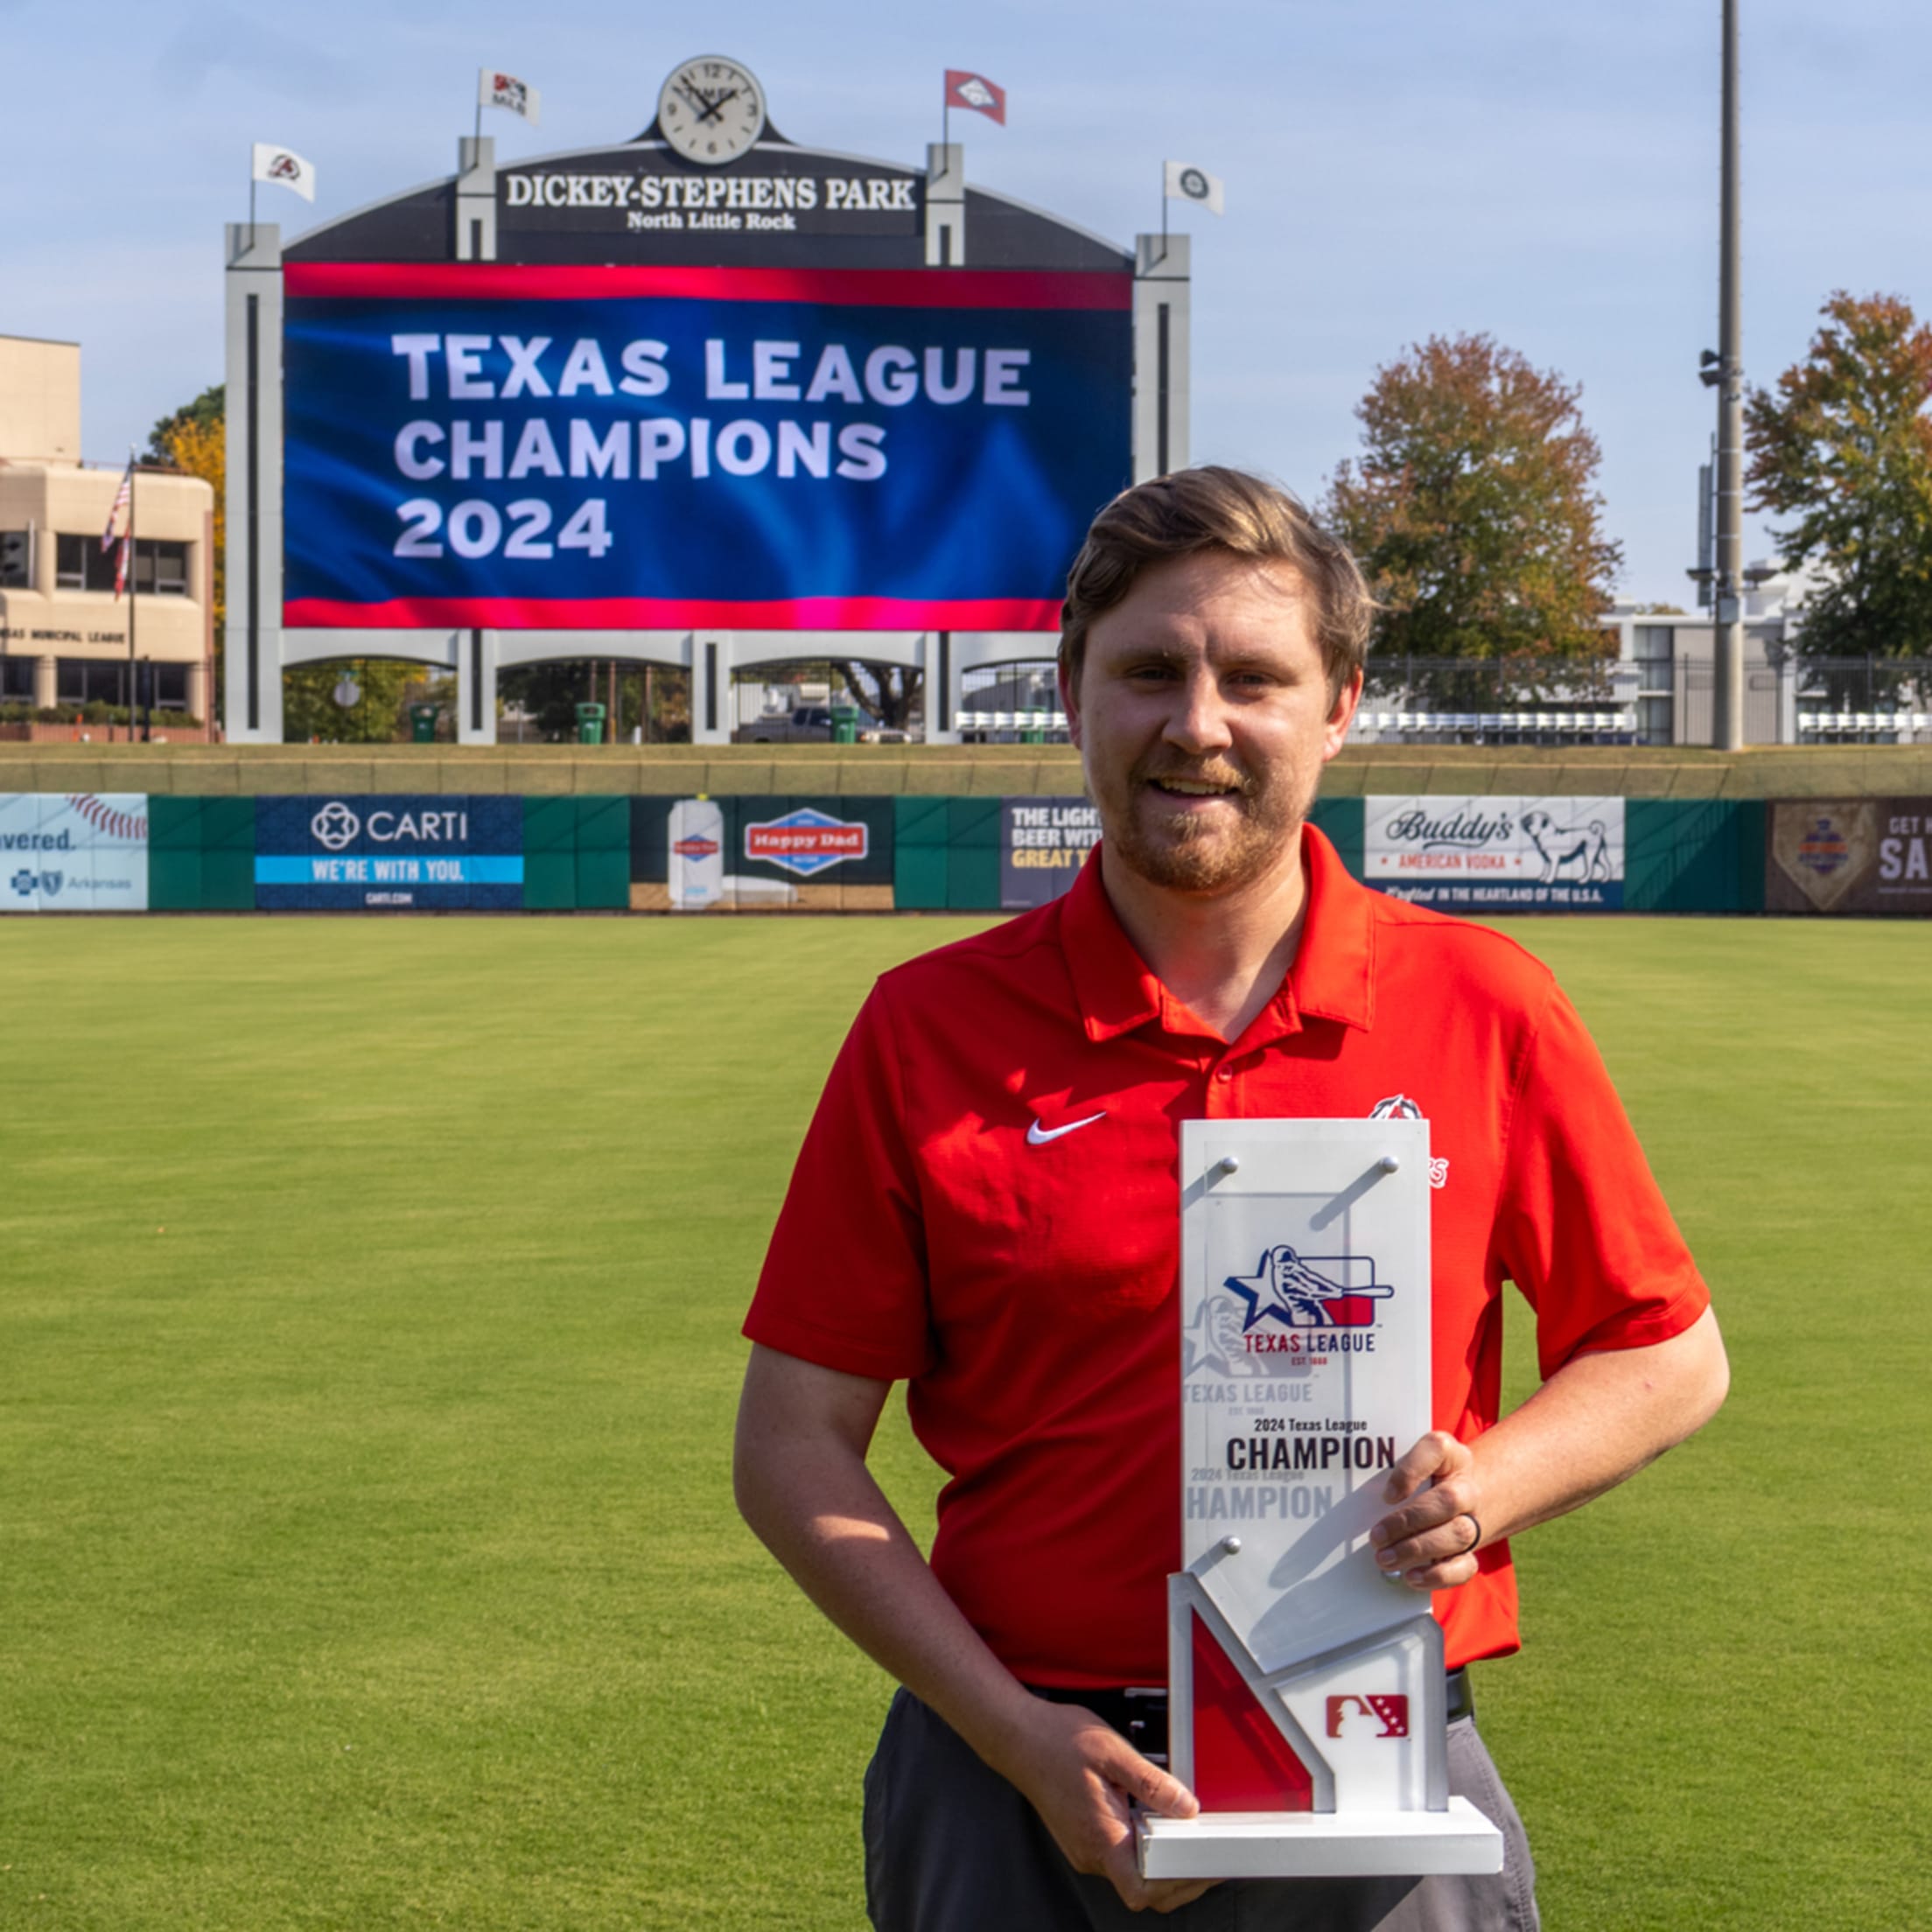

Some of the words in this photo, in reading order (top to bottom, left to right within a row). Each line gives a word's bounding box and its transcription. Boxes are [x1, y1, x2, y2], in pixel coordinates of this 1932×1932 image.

[506, 175, 818, 210] DICKEY-STEPHENS
[824, 178, 917, 210] PARK
[626, 212, 683, 229] North
[688, 212, 742, 230] Little
[746, 213, 796, 231] Rock
[391, 332, 670, 400] TEXAS
[704, 339, 1031, 406] LEAGUE
[394, 417, 887, 480] CHAMPIONS
[394, 498, 613, 558] 2024
[88, 632, 124, 644] LEAGUE
[367, 810, 467, 841] CARTI
[1012, 807, 1049, 827] THE
[1890, 816, 1920, 835] GET
[0, 828, 77, 851] vered.
[1012, 828, 1060, 847] BEER
[1386, 810, 1514, 850] Buddy's
[753, 834, 816, 850] Happy
[820, 833, 858, 847] Dad
[1012, 849, 1073, 868] GREAT
[1398, 854, 1461, 869] AMERICAN
[1466, 855, 1506, 869] VODKA
[312, 859, 368, 882] WE'RE
[374, 860, 419, 882] WITH
[425, 860, 465, 881] YOU.
[67, 876, 131, 889] Arkansas
[1438, 887, 1449, 900] IN
[1452, 887, 1469, 900] THE
[1472, 887, 1533, 901] HEARTLAND
[1536, 887, 1548, 901] OF
[1550, 887, 1570, 901] THE
[1244, 1334, 1301, 1353] TEXAS
[1306, 1334, 1375, 1352] LEAGUE
[1184, 1384, 1237, 1403] TEXAS
[1243, 1383, 1312, 1403] LEAGUE
[1254, 1418, 1285, 1432] 2024
[1289, 1418, 1322, 1432] Texas
[1326, 1418, 1368, 1433] League
[1227, 1437, 1395, 1471] CHAMPION
